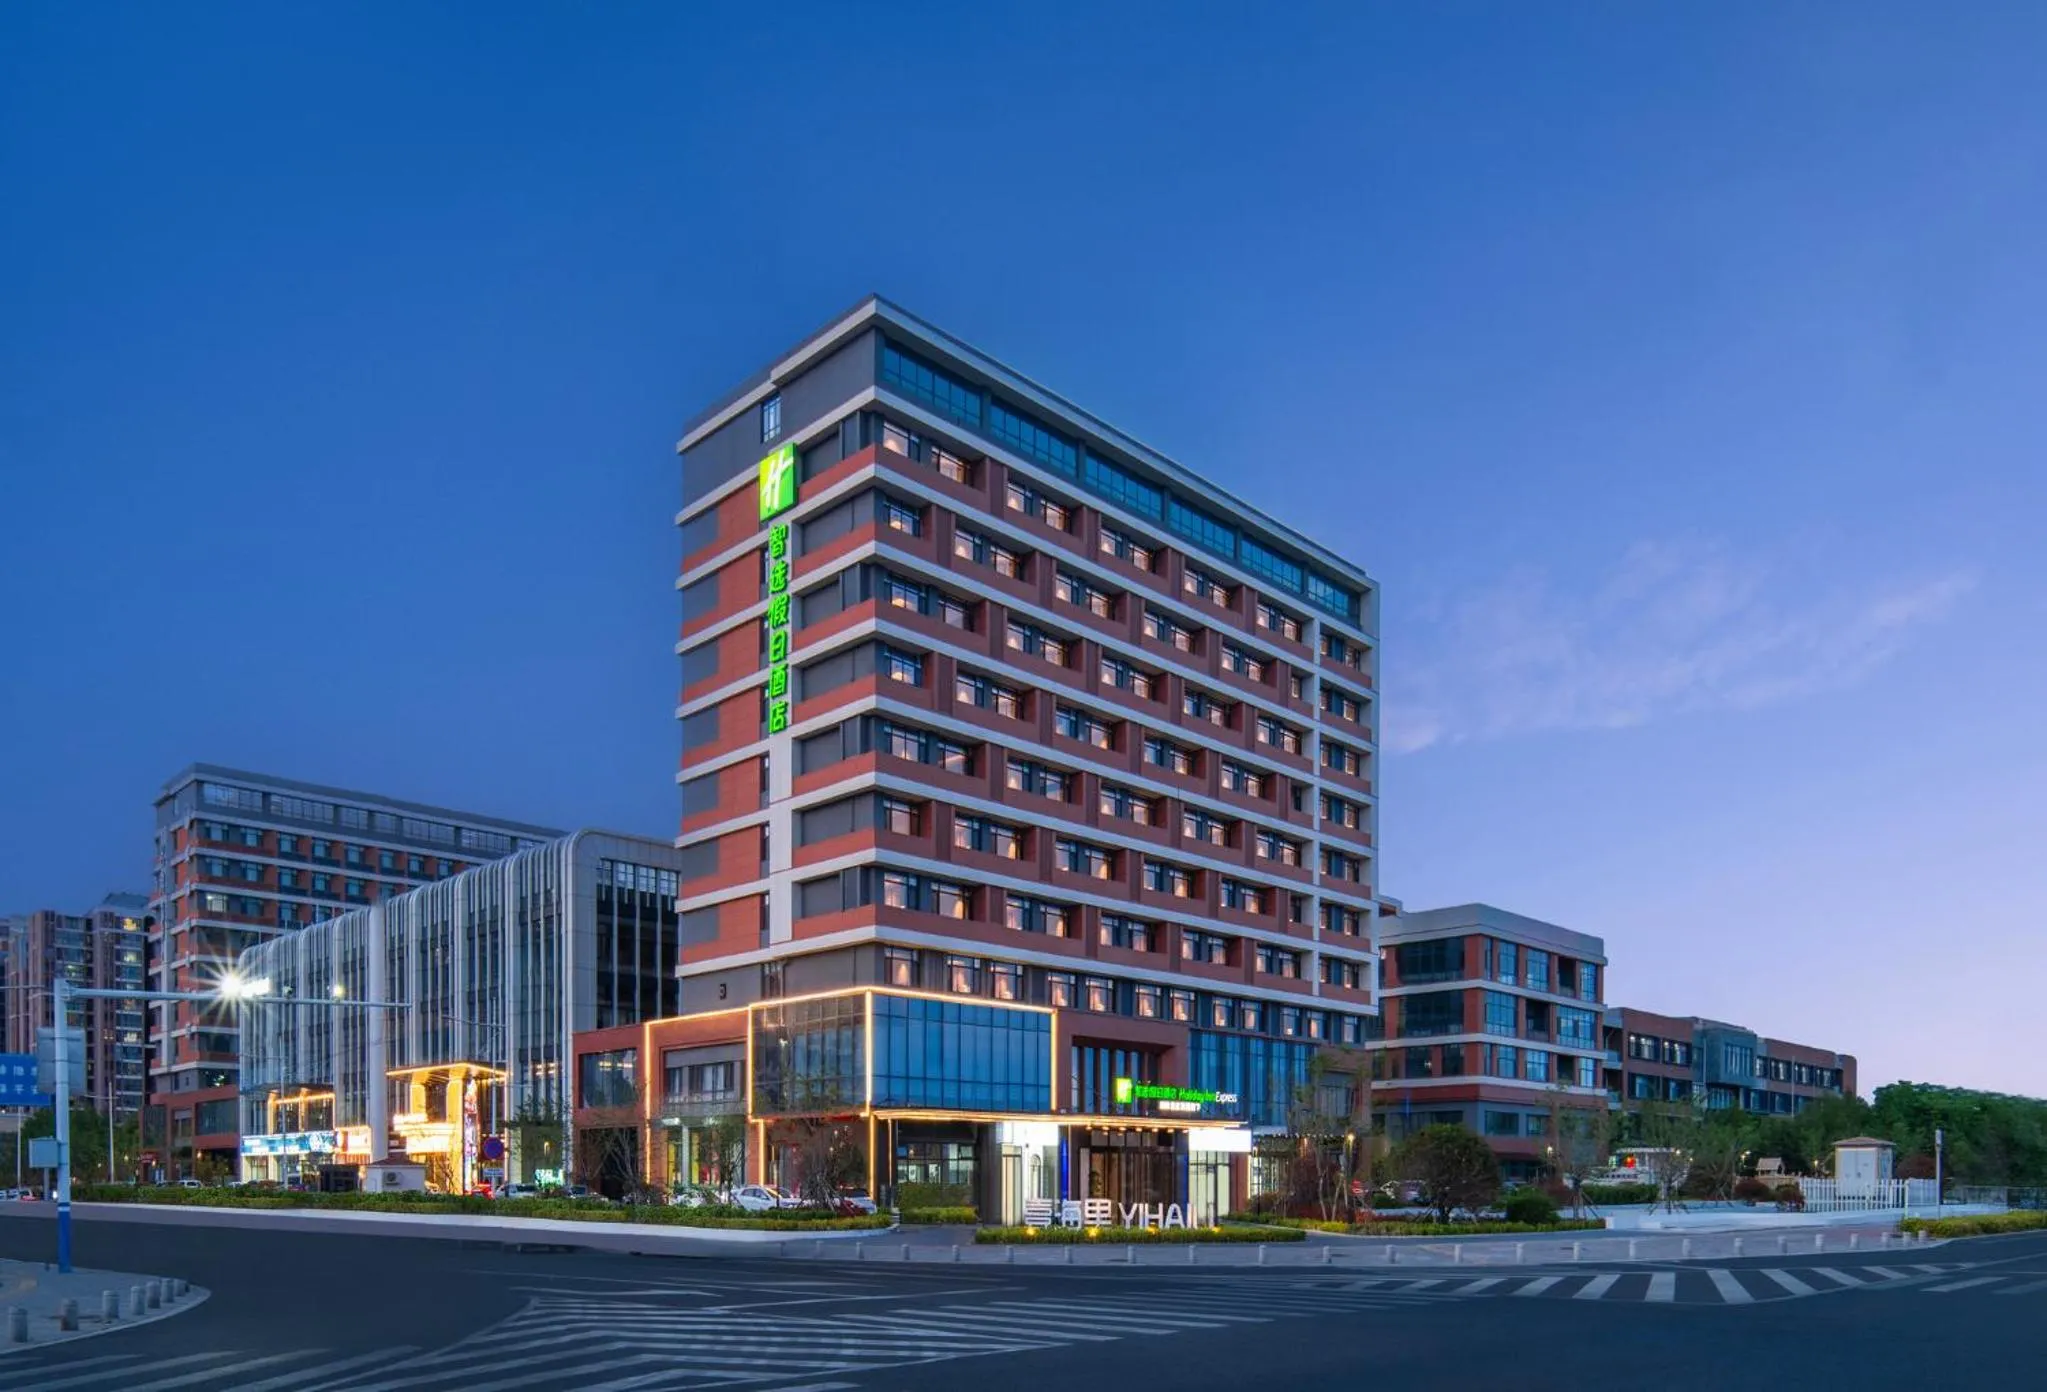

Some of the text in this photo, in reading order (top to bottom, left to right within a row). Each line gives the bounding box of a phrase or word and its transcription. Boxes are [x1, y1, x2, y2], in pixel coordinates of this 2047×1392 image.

[769, 524, 789, 734] 智选假日酒店
